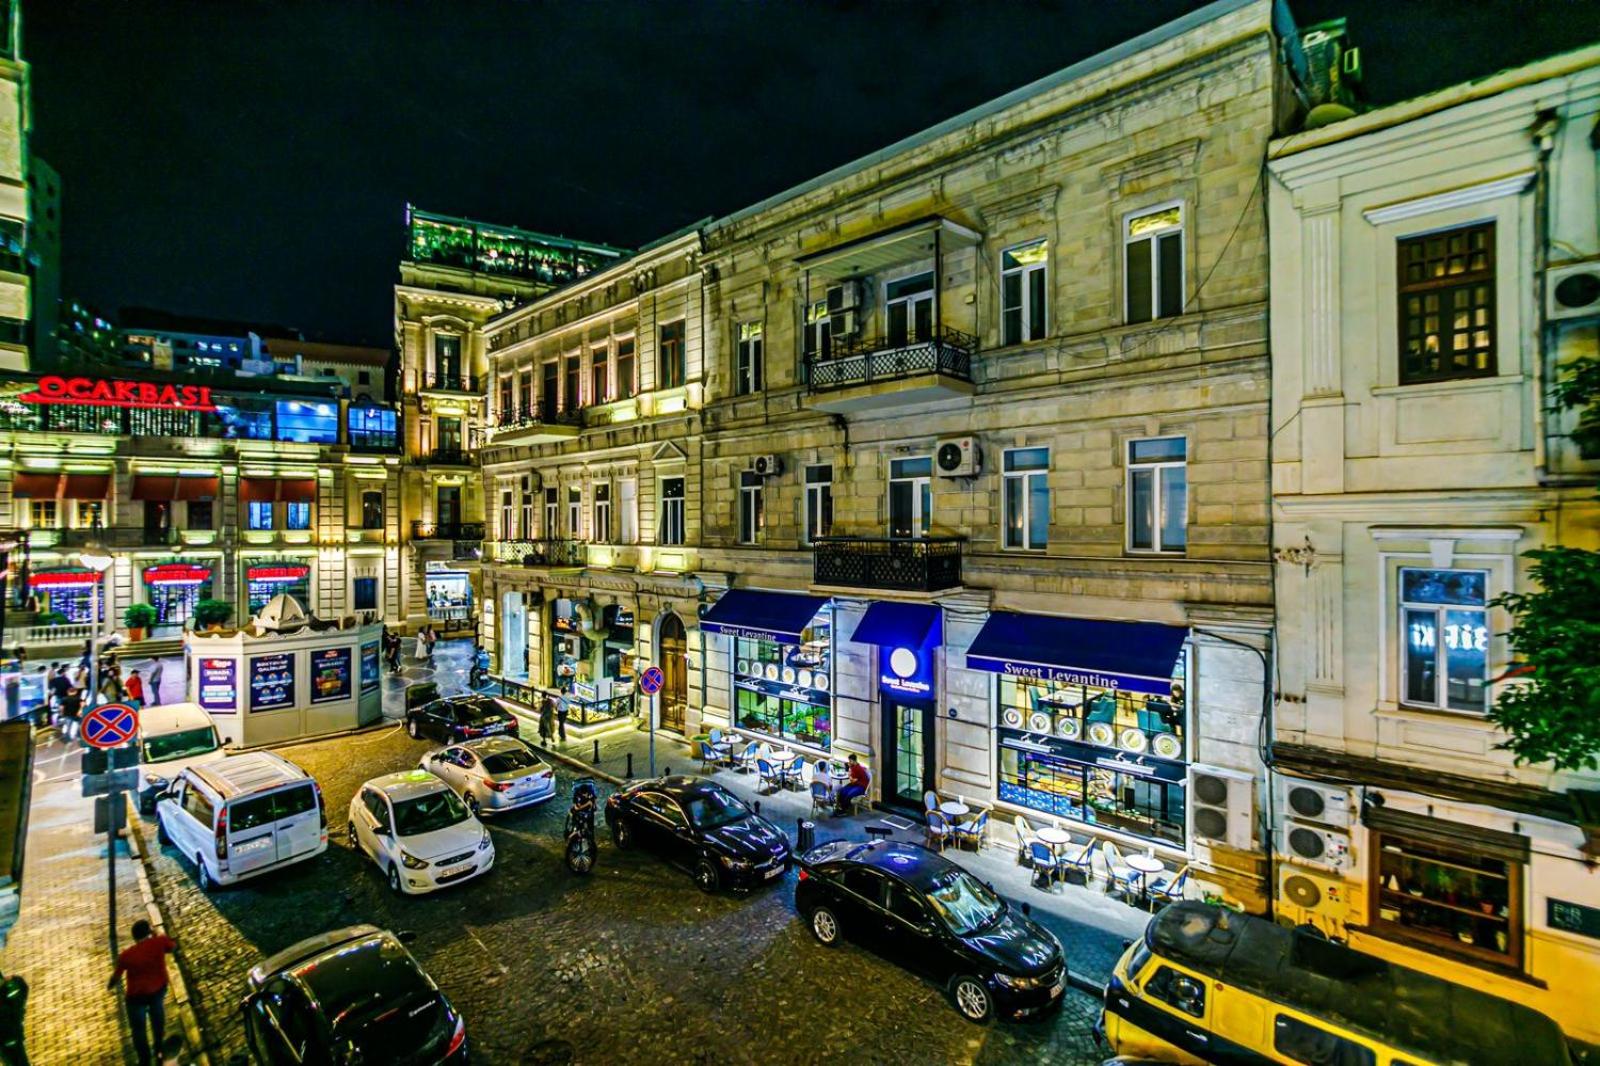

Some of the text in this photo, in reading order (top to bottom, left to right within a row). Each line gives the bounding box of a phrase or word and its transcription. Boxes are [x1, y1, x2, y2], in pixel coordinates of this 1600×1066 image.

[720, 626, 777, 641] Sweet Levantine
[1004, 662, 1119, 689] Sweet Levantine
